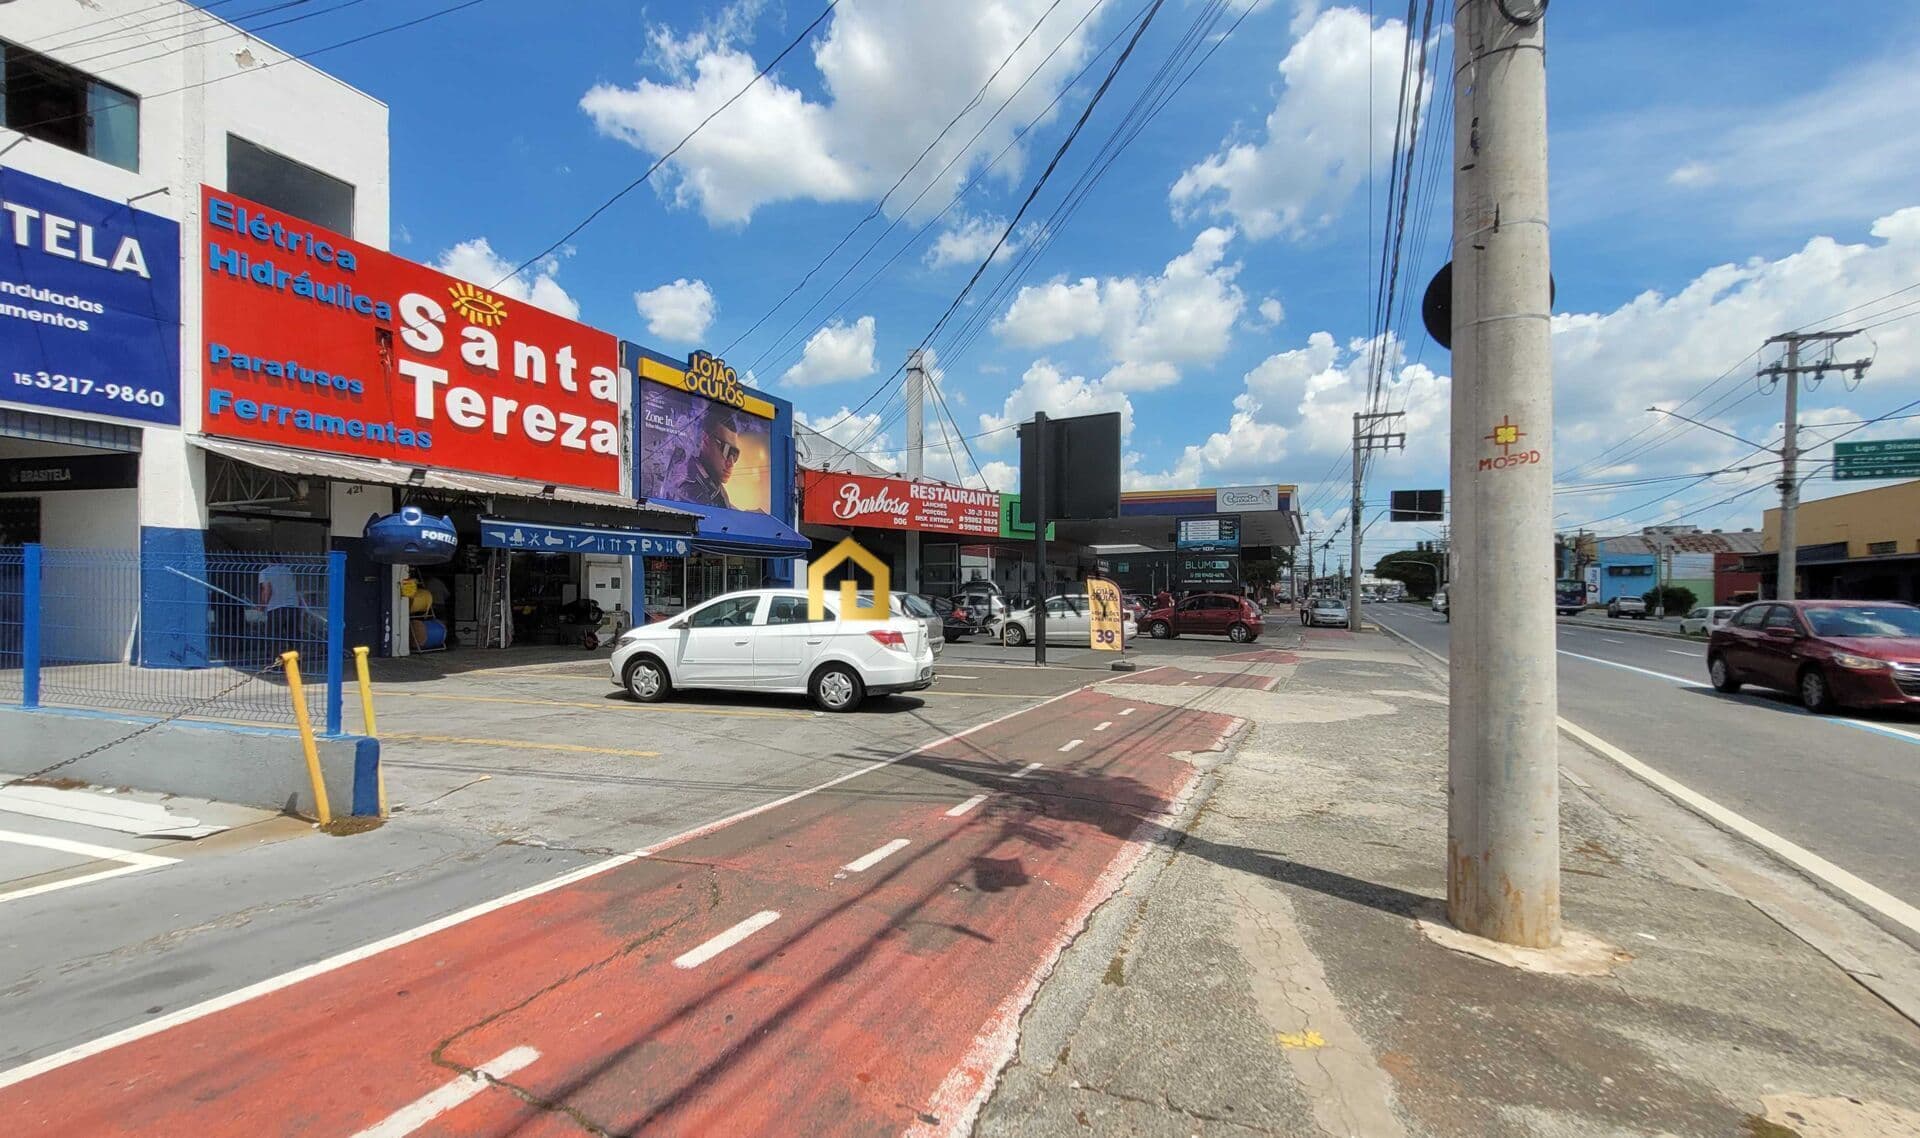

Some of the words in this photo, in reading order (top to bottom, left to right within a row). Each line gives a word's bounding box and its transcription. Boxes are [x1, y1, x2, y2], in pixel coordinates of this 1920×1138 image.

[2, 201, 152, 279] TELA
[209, 197, 357, 271] Elétrica
[209, 243, 392, 321] Hidráulica
[209, 343, 364, 394] Parafusos
[398, 292, 618, 404] Santa
[13, 372, 33, 386] 15
[35, 371, 165, 407] 3217-9860
[209, 388, 433, 448] Ferramentas
[398, 359, 619, 456] Tereza
[832, 482, 910, 519] Barbosa
[910, 484, 1000, 508] RESTAURANTE
[1095, 629, 1115, 644] 39
